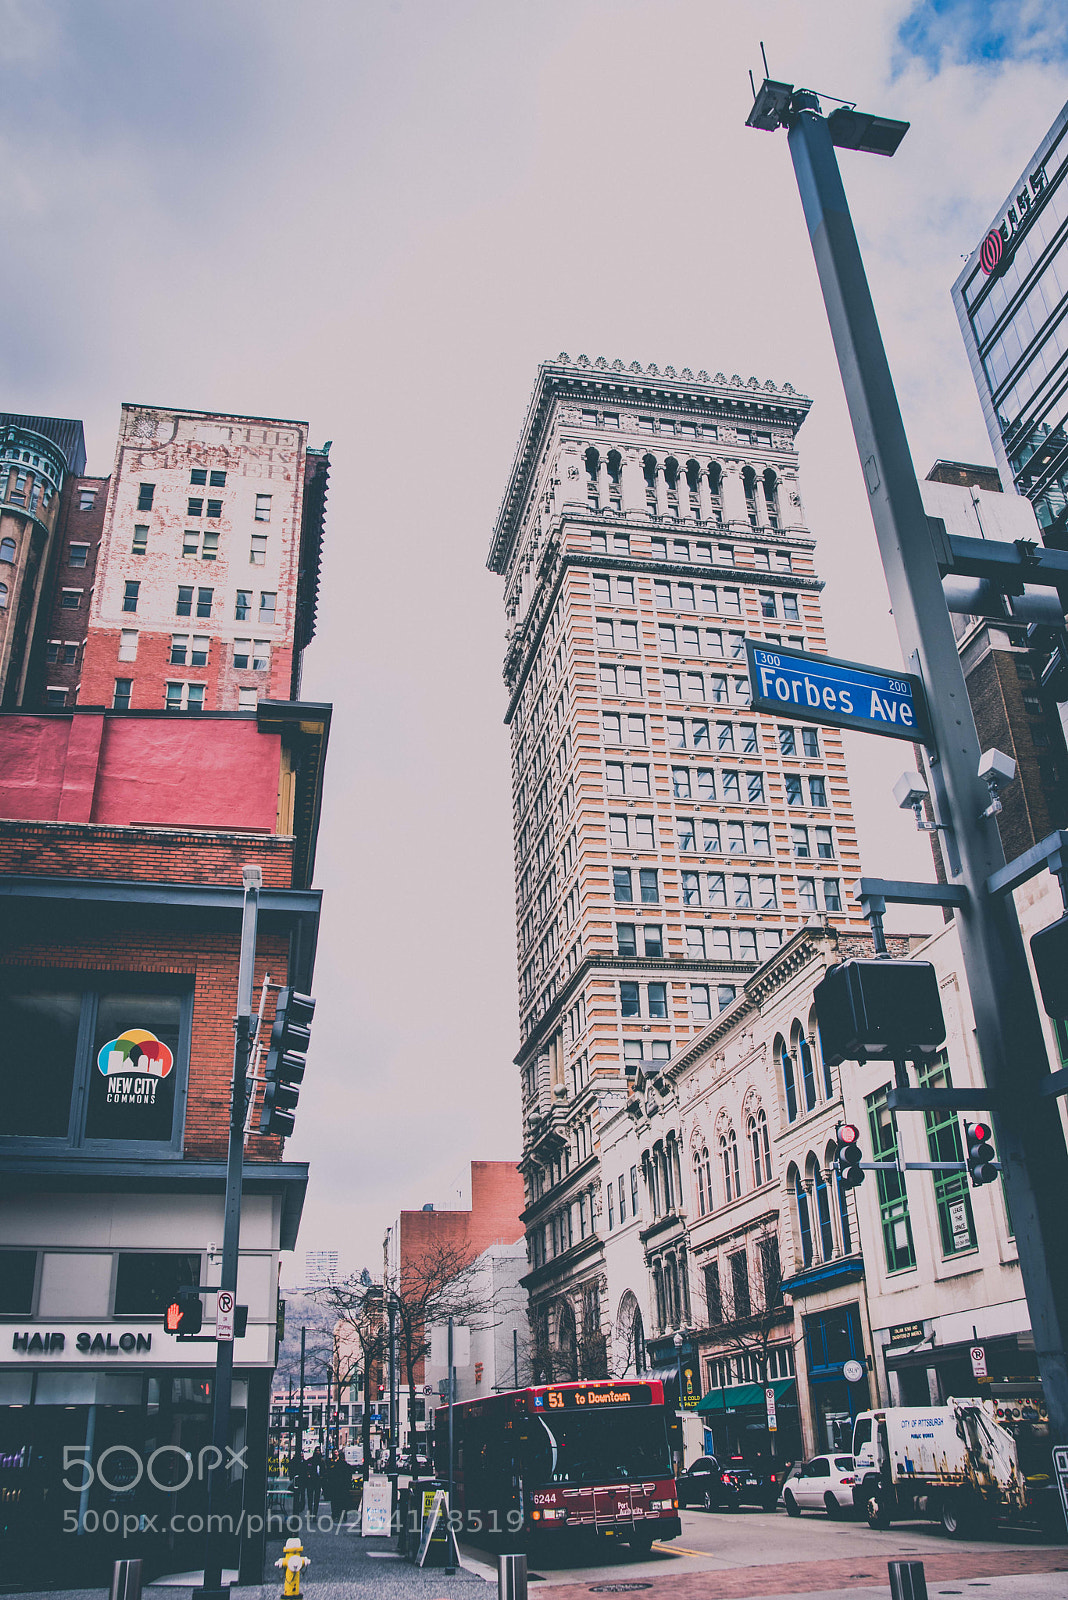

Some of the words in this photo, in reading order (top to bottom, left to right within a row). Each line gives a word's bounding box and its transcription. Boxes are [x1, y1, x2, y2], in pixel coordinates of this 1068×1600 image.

[760, 652, 781, 667] 300
[888, 679, 907, 693] 200
[760, 667, 854, 714] Forbes
[870, 690, 913, 726] Ave
[107, 1077, 133, 1094] NEW
[134, 1078, 158, 1095] CITY
[106, 1093, 156, 1105] COMMONS
[12, 1332, 65, 1352] HAIR
[76, 1332, 152, 1352] SALON
[548, 1391, 565, 1408] 51
[575, 1392, 586, 1405] to
[588, 1390, 631, 1404] Downtown
[901, 1419, 910, 1428] CITY
[911, 1418, 917, 1427] OF
[918, 1417, 944, 1427] PITTSBURGH
[533, 1493, 557, 1504] 6244
[617, 1501, 629, 1509] Port
